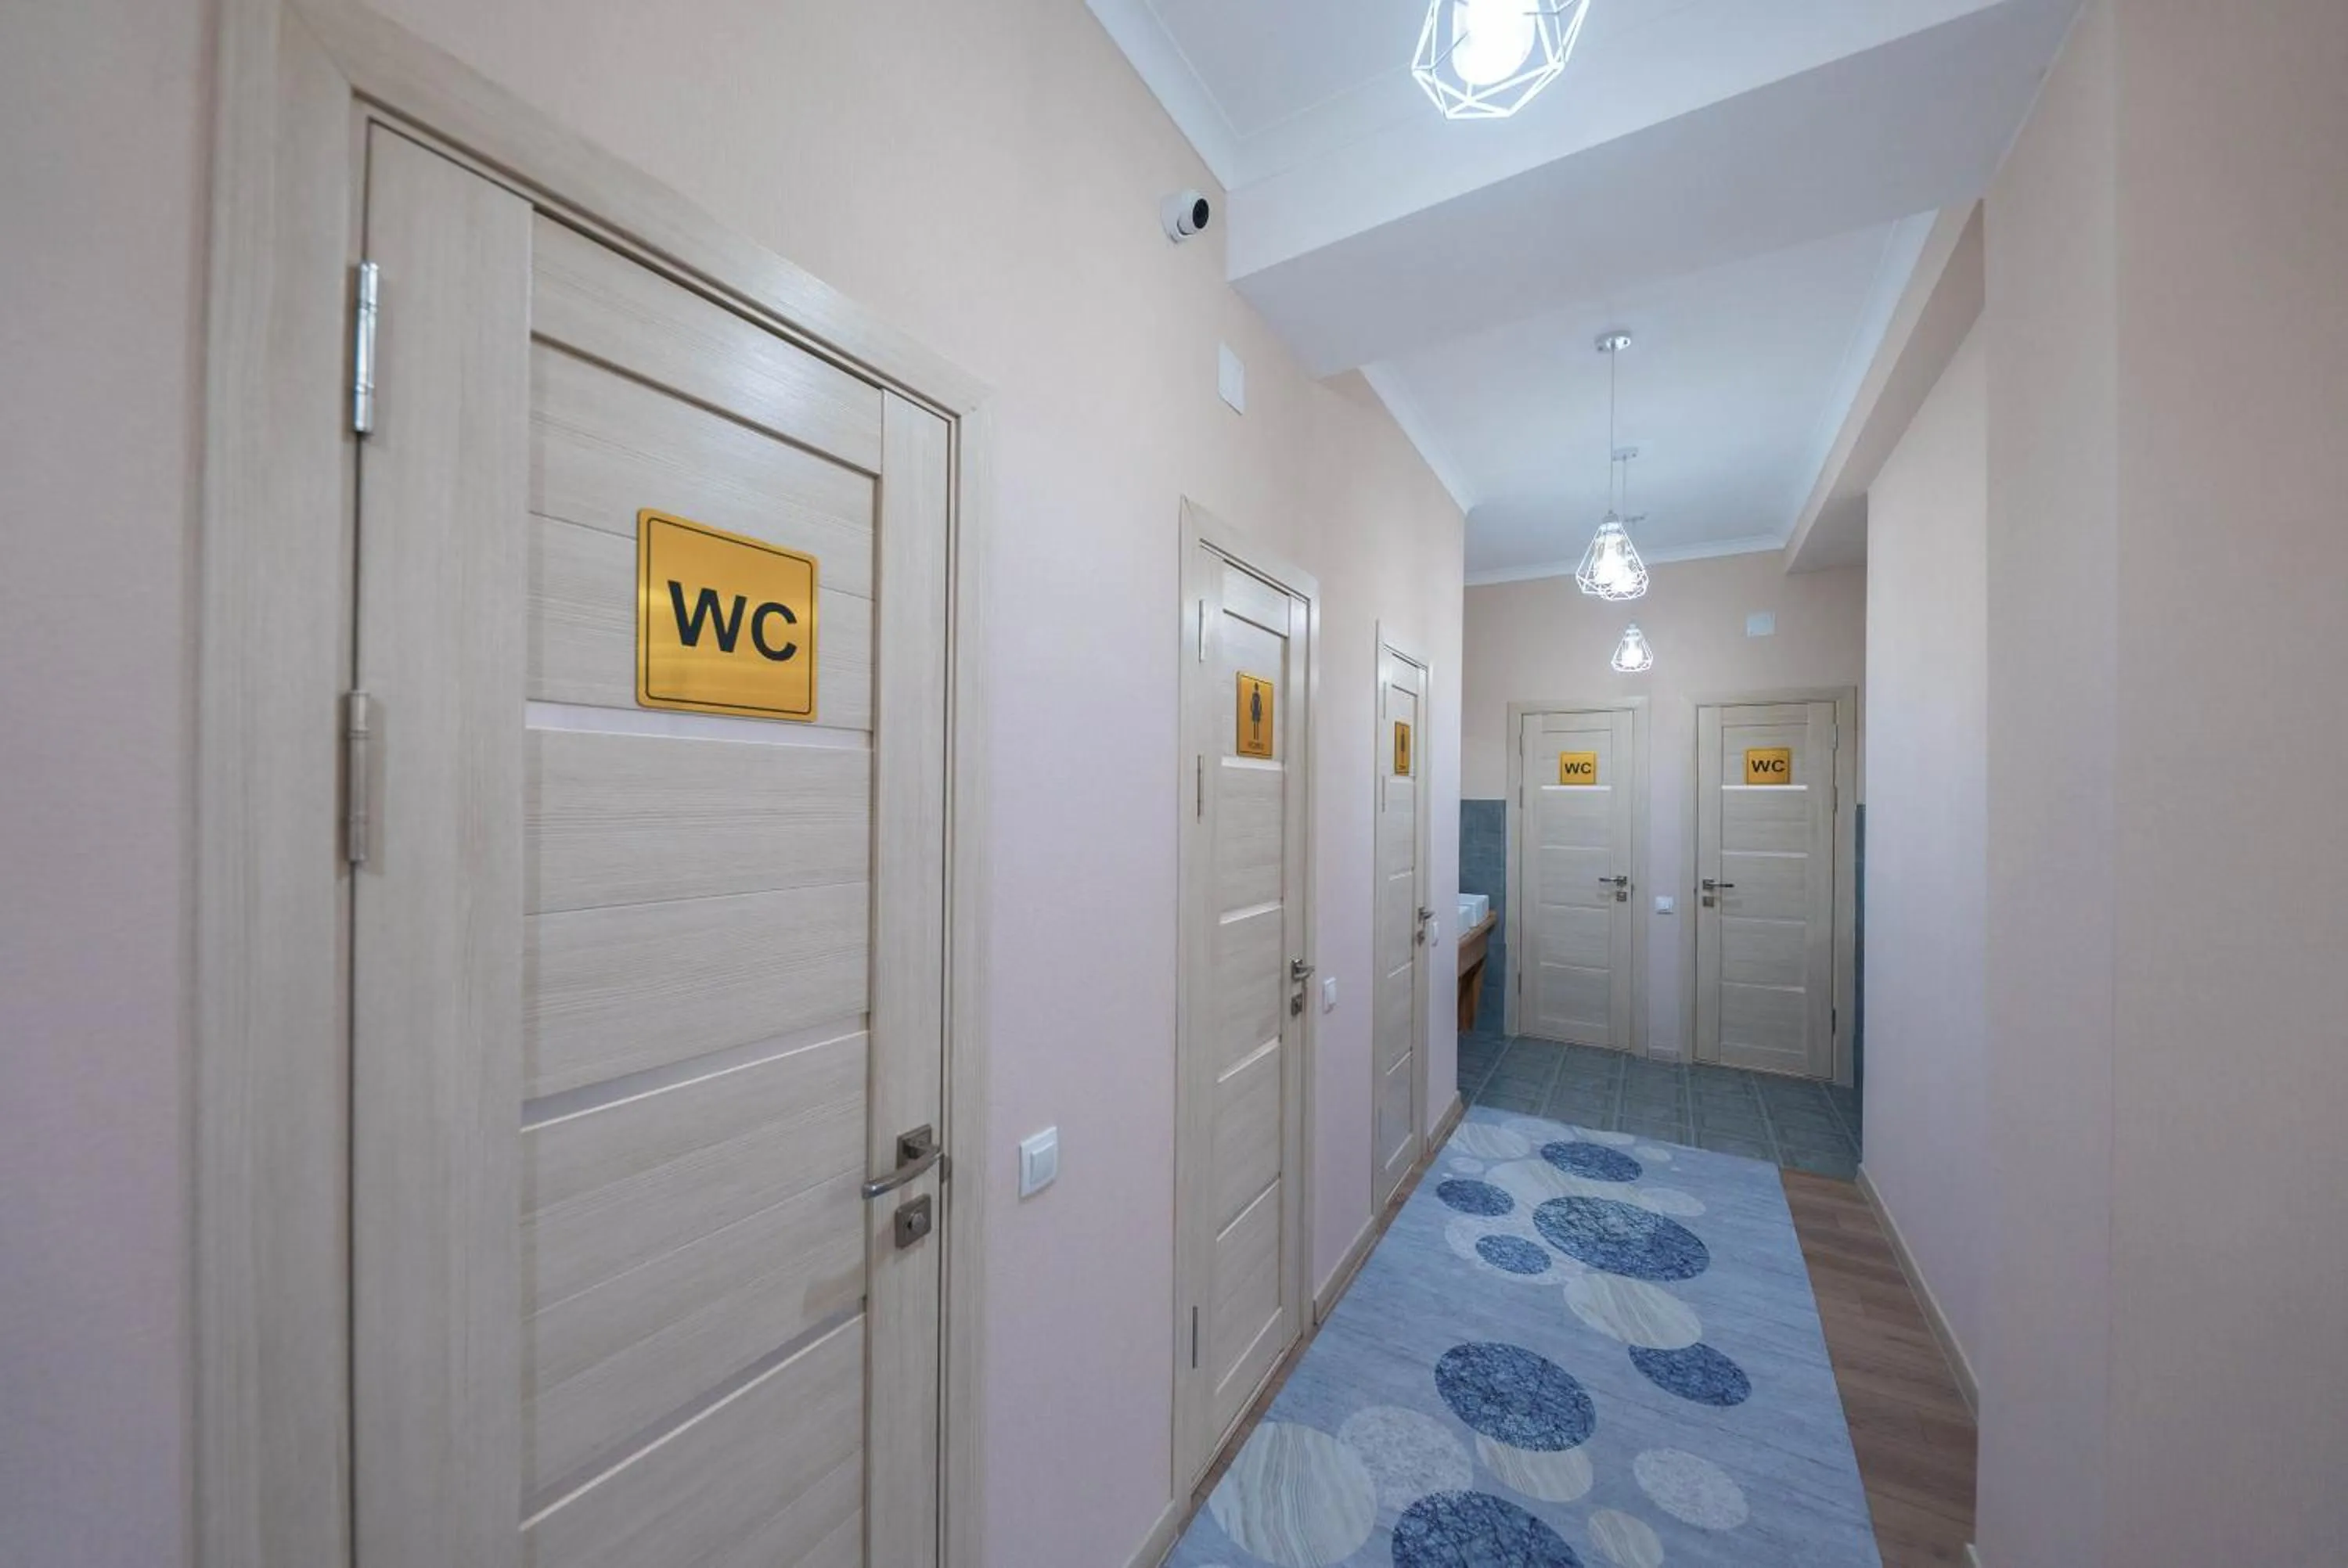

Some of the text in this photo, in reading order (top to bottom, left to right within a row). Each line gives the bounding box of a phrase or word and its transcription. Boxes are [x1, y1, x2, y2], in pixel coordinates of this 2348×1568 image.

[668, 580, 798, 662] WC
[1565, 762, 1591, 774] WC
[1752, 760, 1785, 773] WC
